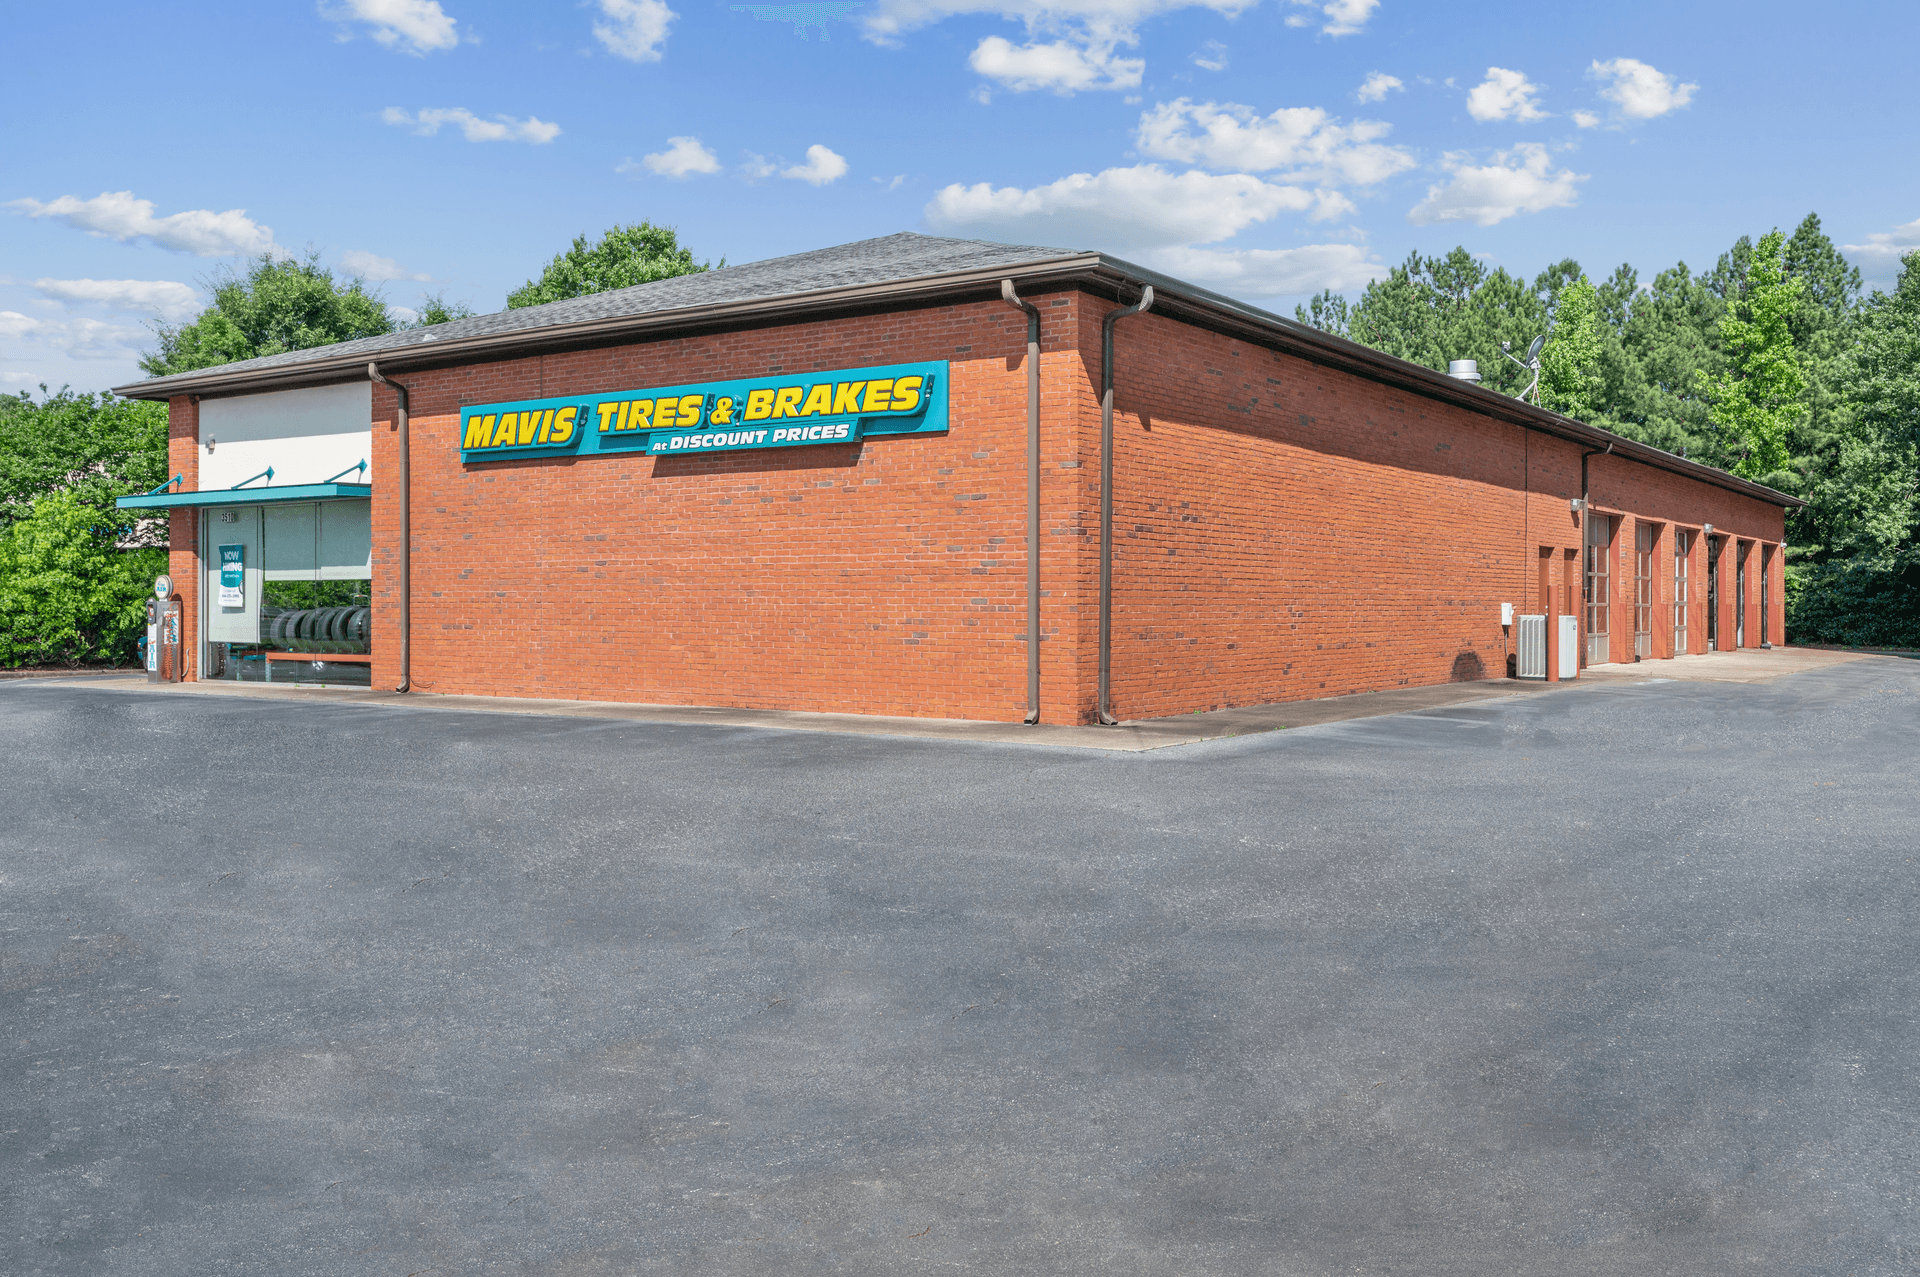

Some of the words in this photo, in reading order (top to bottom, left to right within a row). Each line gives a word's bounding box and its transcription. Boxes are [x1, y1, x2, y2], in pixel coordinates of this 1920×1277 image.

[462, 406, 578, 450] MAVIS
[596, 394, 704, 432] TIRES
[709, 396, 736, 425] &
[743, 375, 924, 421] BRAKES
[652, 442, 668, 451] At
[669, 430, 768, 450] DISCOUNT
[772, 424, 850, 443] PRICES
[224, 551, 239, 560] NOW
[222, 562, 243, 571] HIRING
